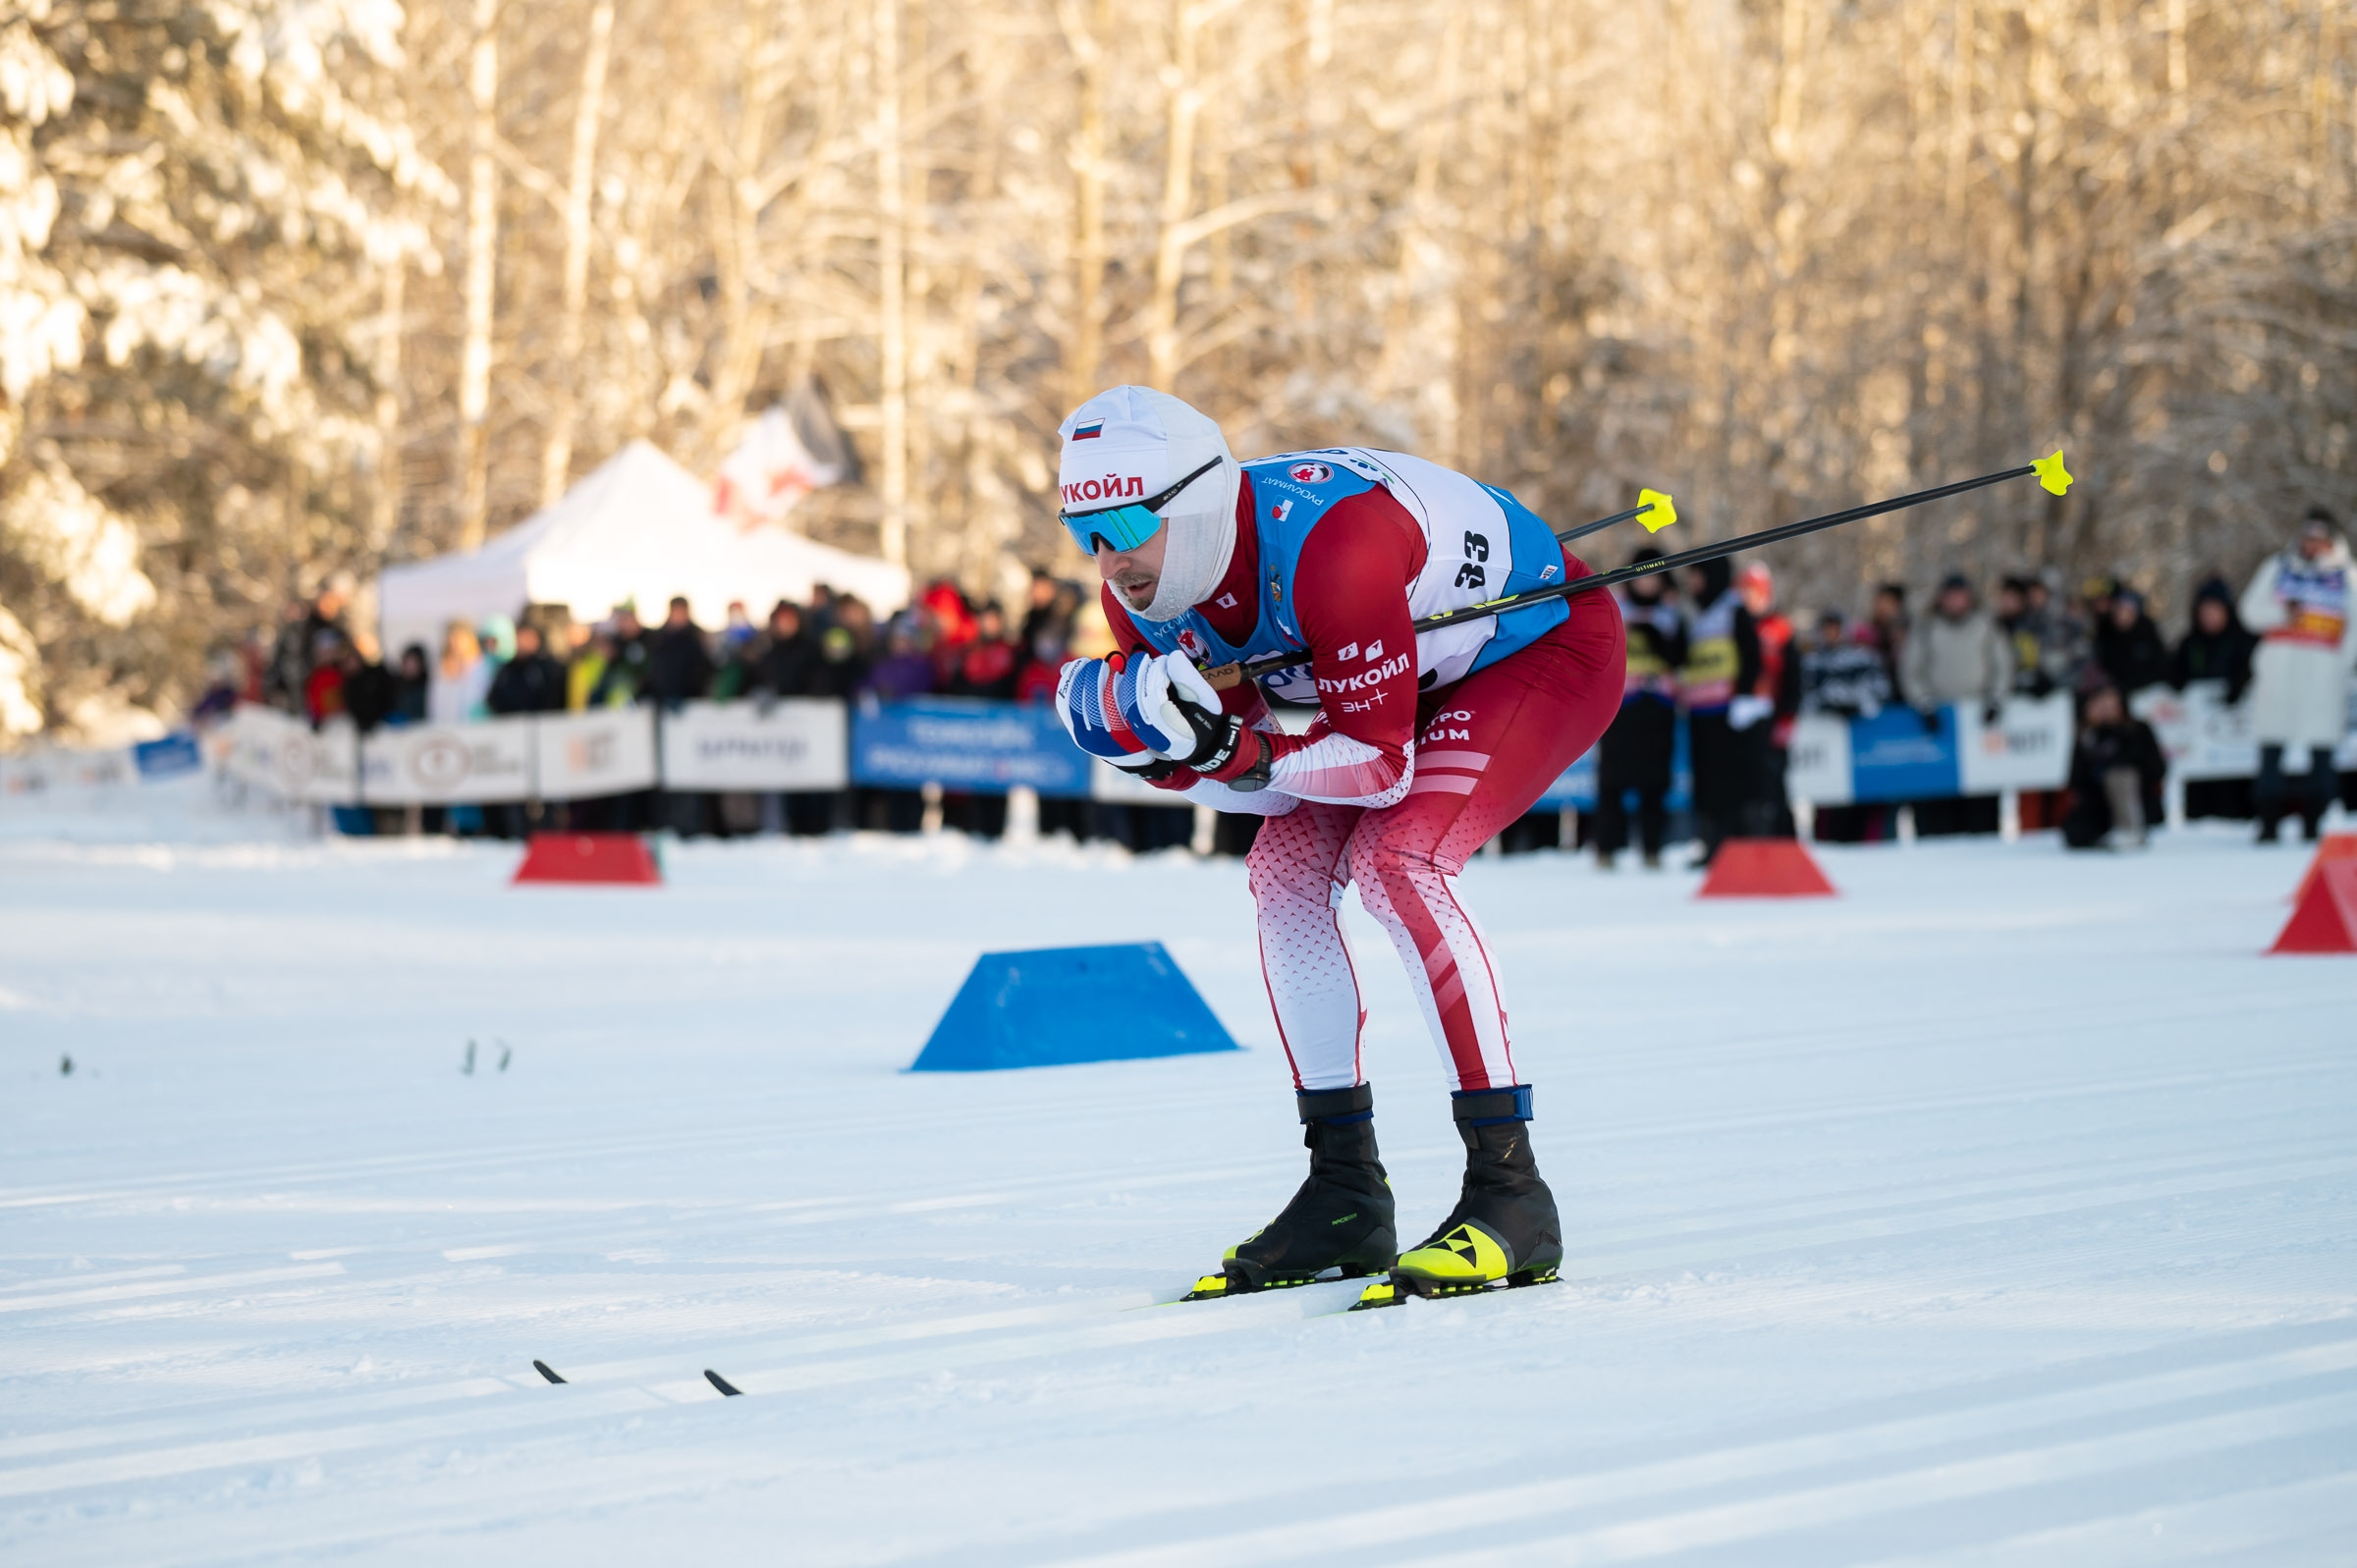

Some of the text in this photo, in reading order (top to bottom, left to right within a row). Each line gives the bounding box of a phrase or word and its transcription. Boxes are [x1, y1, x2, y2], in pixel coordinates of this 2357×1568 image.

[1061, 473, 1144, 504] УКОЙЛ
[1261, 476, 1325, 507] РУСКЛИМАТ
[1454, 529, 1489, 589] 33
[1635, 560, 1666, 572] ULTIMATE
[1318, 652, 1410, 693] ЛУКОЙЛ
